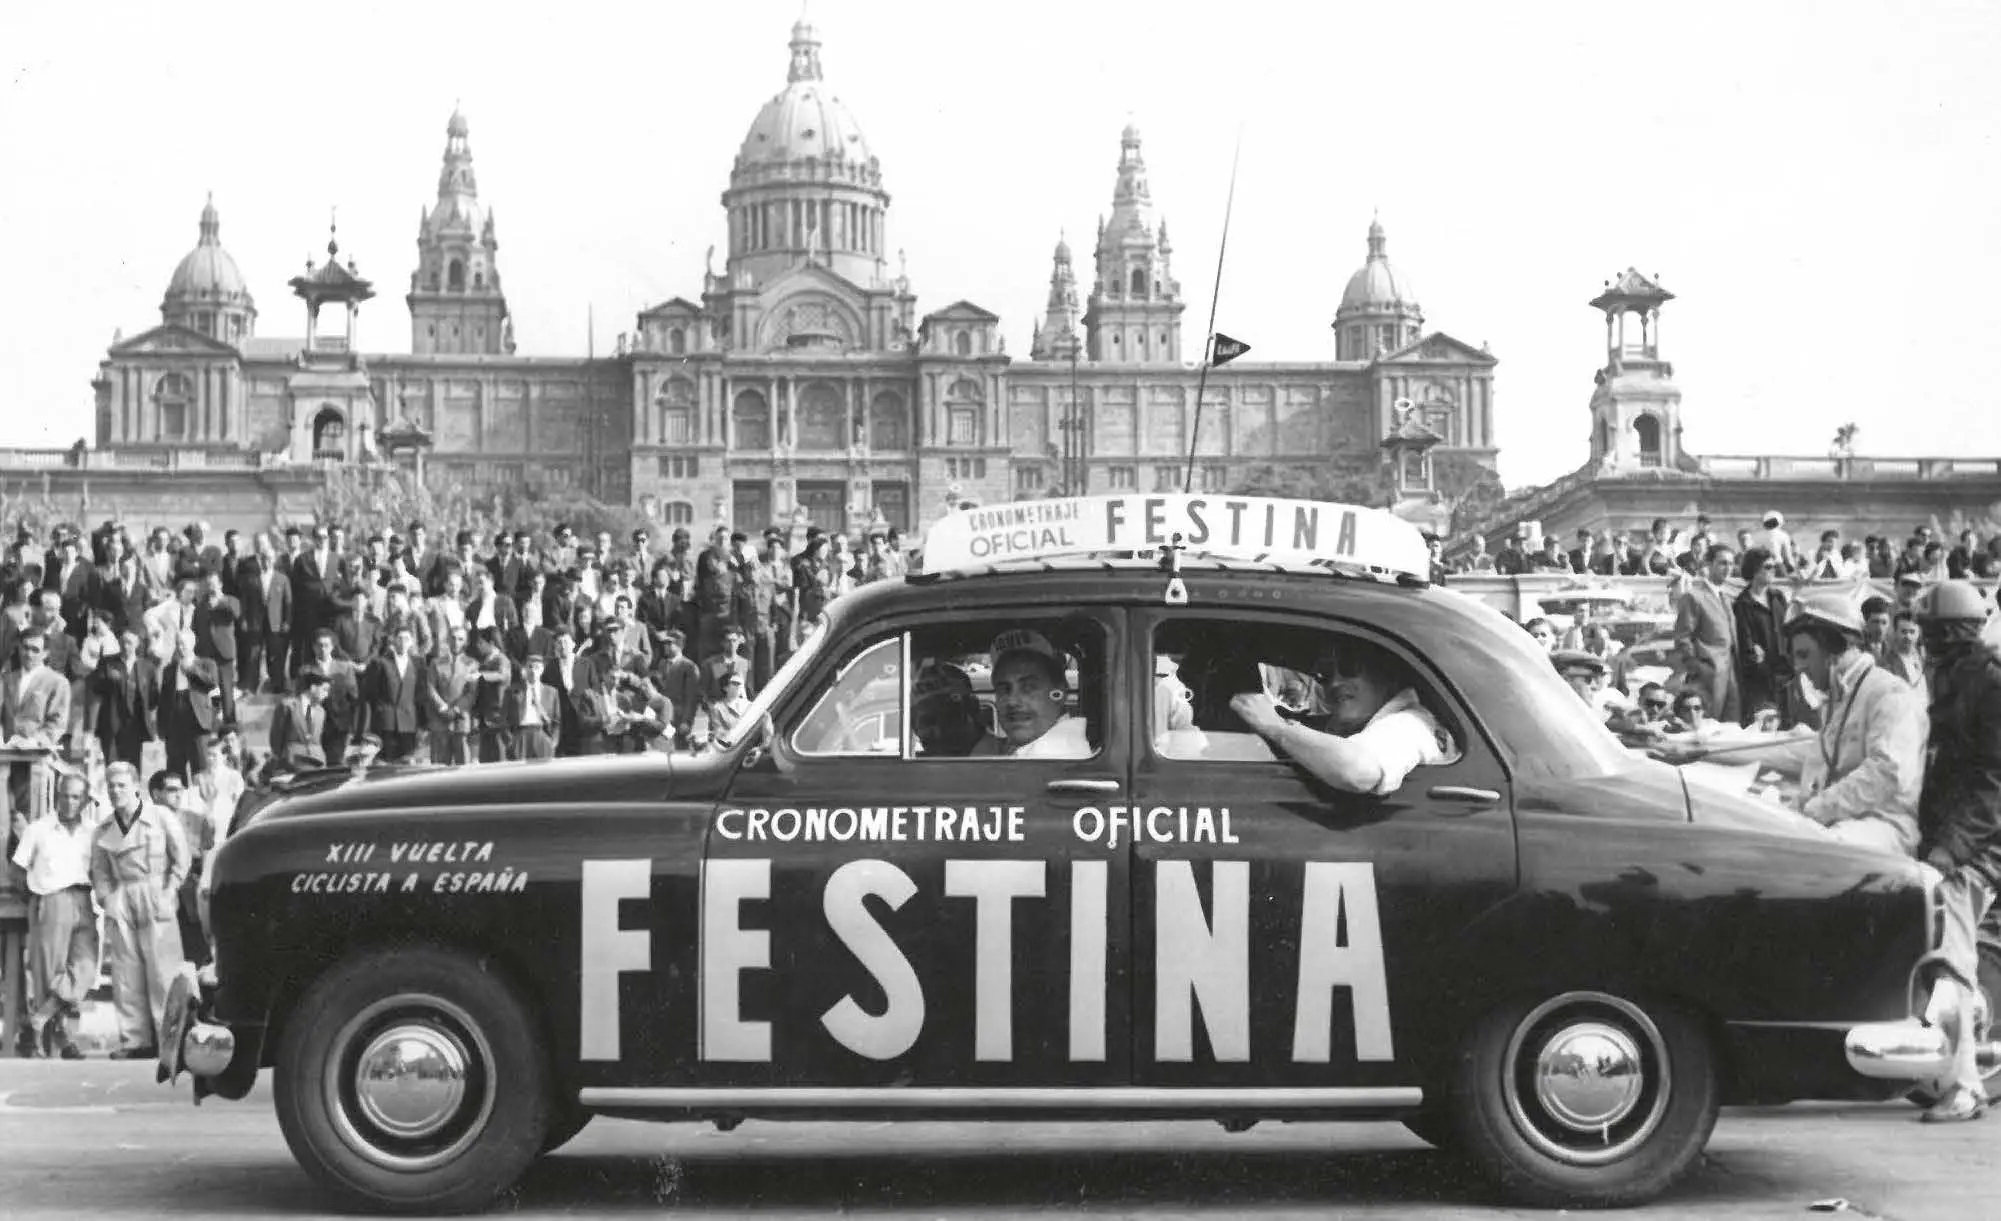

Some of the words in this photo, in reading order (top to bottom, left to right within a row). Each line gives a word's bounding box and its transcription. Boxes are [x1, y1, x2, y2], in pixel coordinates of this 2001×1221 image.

[970, 527, 1075, 557] OFICIAL
[1106, 499, 1357, 556] FESTINA
[716, 807, 1025, 841] CRONOMETRAJE
[1073, 807, 1240, 843] OFICIAL
[326, 842, 376, 863] XIII
[391, 842, 494, 863] VUELTA
[291, 873, 392, 893] CICLISTA
[401, 873, 420, 893] A
[433, 866, 529, 893] ESPAÑA
[580, 859, 1394, 1062] FESTINA
